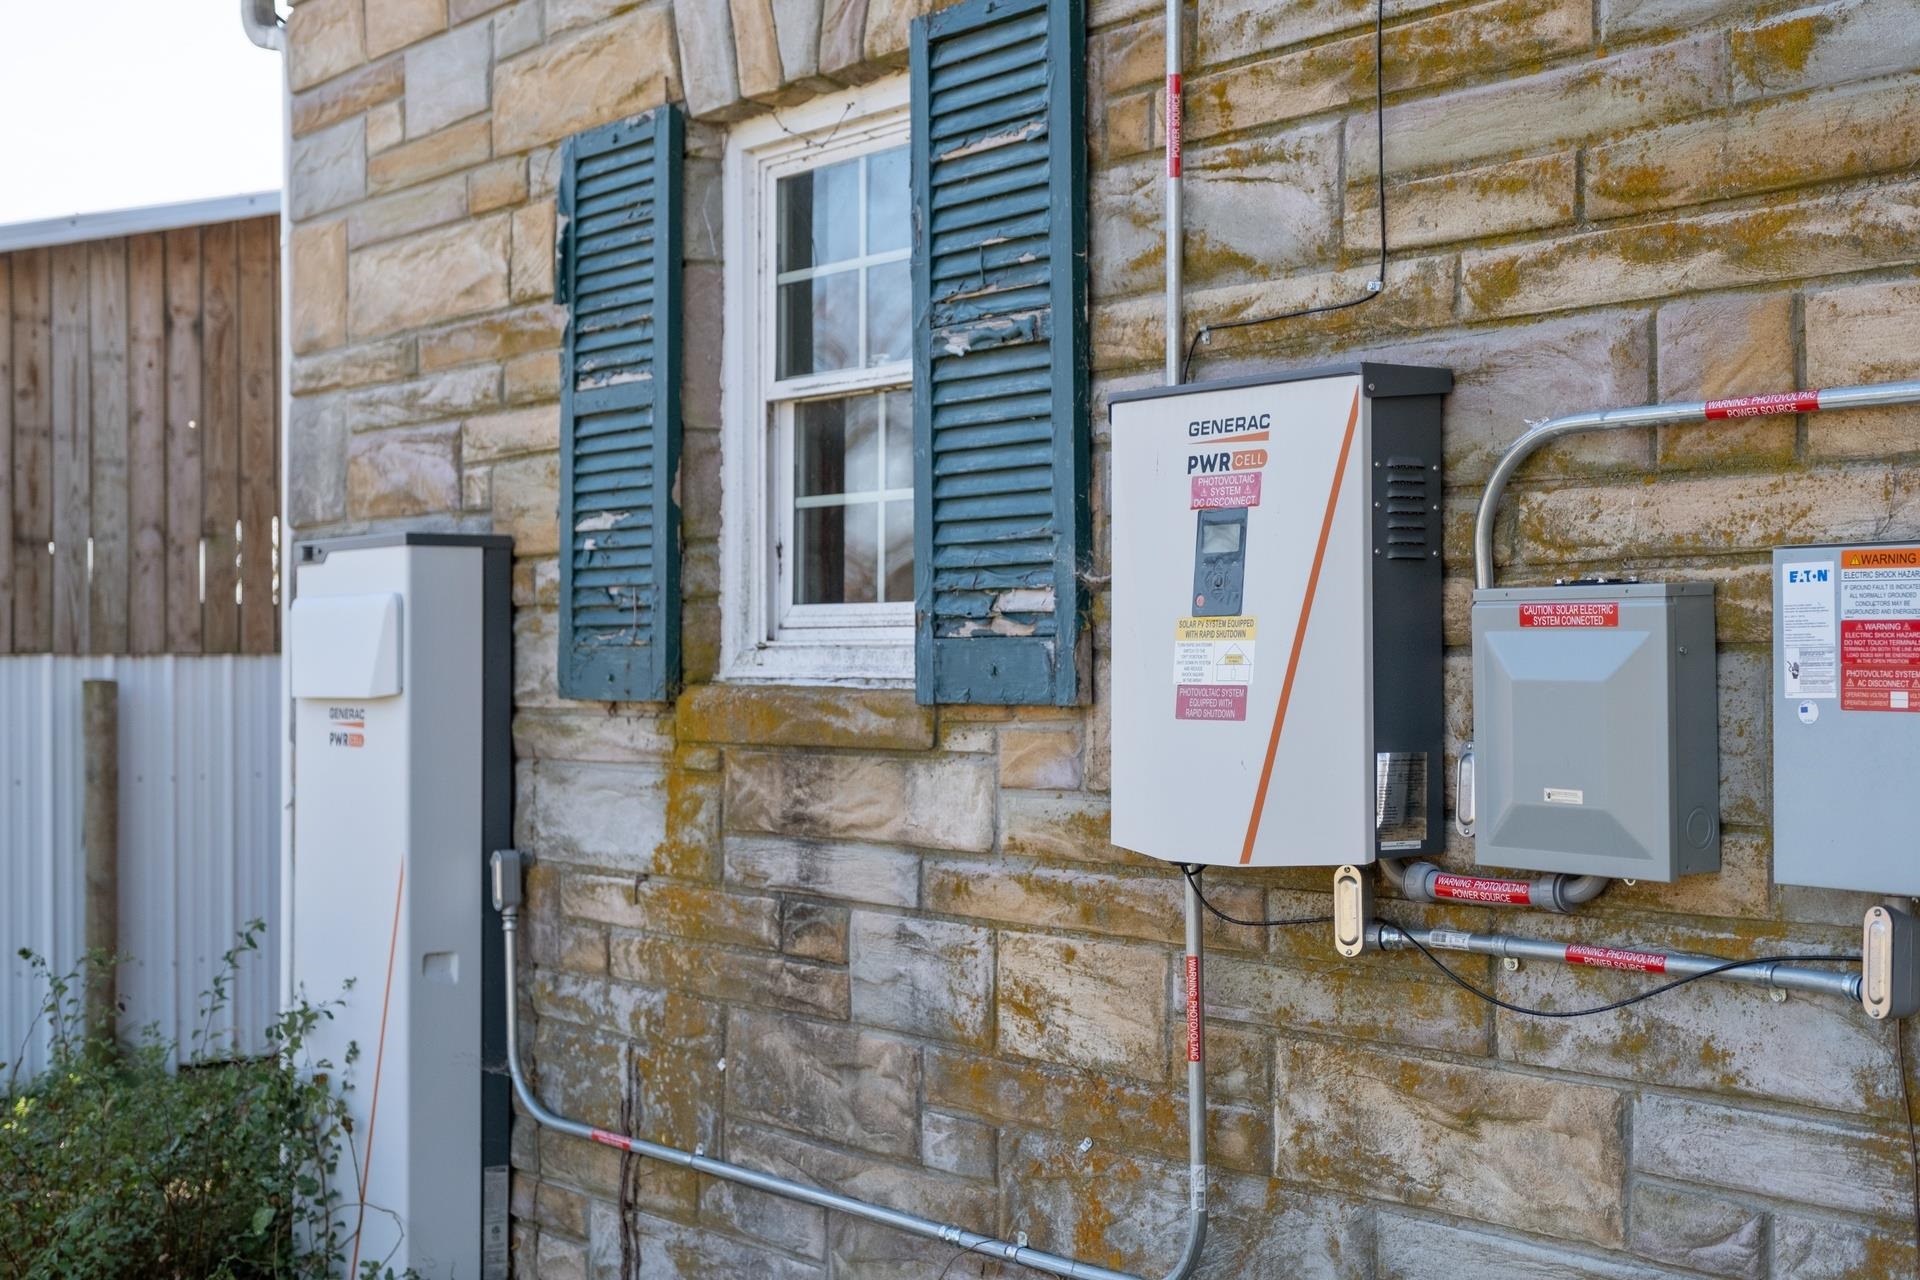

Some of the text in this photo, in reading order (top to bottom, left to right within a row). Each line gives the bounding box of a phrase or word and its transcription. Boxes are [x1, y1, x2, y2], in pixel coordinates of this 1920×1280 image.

[1171, 93, 1180, 158] POWER SOURCE
[1751, 390, 1817, 405] PHOTOVOLTAIC
[1726, 403, 1798, 418] POWER SOURCE
[1189, 413, 1271, 437] GENERAC
[1187, 452, 1263, 475] PWR CELL
[1198, 474, 1255, 486] PHOTOVOLTAIC
[1210, 486, 1241, 497] SYSTEM
[1193, 496, 1256, 508] DC DISCONNECT
[1861, 553, 1917, 565] WARNING
[1844, 570, 1920, 579] ELECTRIC SHOCK HAZAR
[1556, 605, 1579, 615] SOLAR
[1580, 604, 1614, 615] ELECTRIC
[1179, 619, 1254, 628] SOLAR PV SYSTEM EQUIPPED
[1533, 615, 1604, 626] SYSTEM CONNECTED
[1864, 622, 1901, 630] WARNING
[1185, 629, 1247, 639] WITH RAPID SHUTDOWN
[1846, 670, 1894, 678] PHOTOVOLTAIC
[1857, 679, 1909, 687] AC DISCONNECT
[1179, 688, 1245, 697] PHOTOVOLTAIC SYSTEM
[1189, 698, 1233, 707] EQUIPPED WITH
[329, 707, 365, 720] GENERAC
[1185, 708, 1236, 718] RAPID SHUTDOWN
[1437, 876, 1528, 894] WARNING: PHOTOVOLTAIC
[1451, 888, 1512, 903] POWER SOURCE
[1583, 956, 1612, 968] POWER
[1606, 949, 1664, 967] PHOTOVOLTAIC
[1188, 959, 1199, 1060] WARNING: PHOTOVOLTAIC
